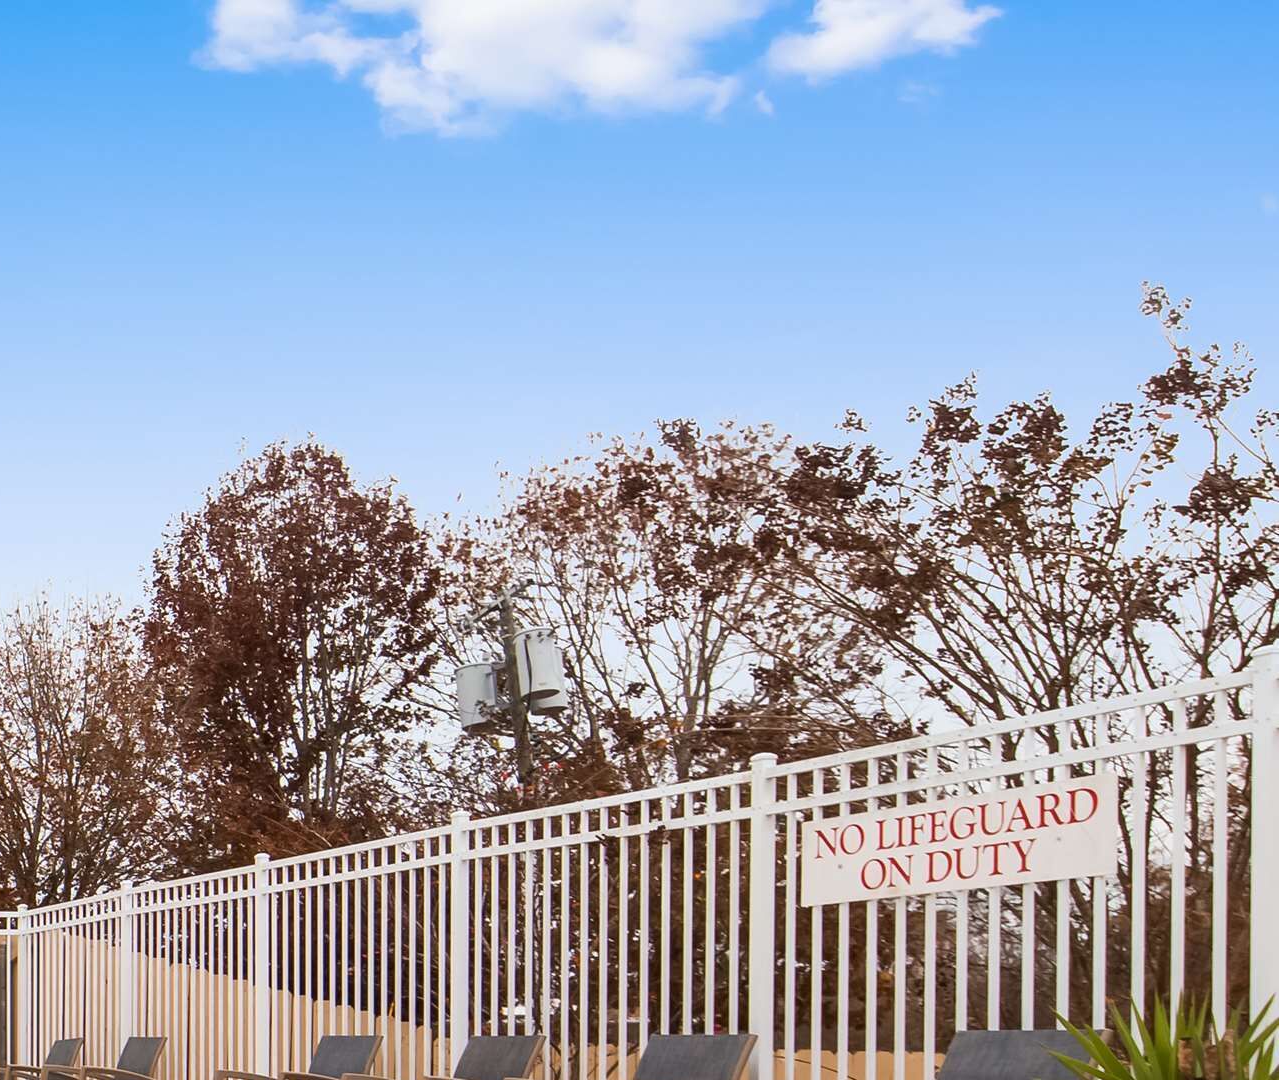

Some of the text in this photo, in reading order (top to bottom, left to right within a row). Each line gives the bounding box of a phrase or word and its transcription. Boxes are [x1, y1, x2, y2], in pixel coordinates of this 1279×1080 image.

[814, 787, 1099, 859] NO LIFEGUARD
[861, 839, 1036, 890] ON DUTY
